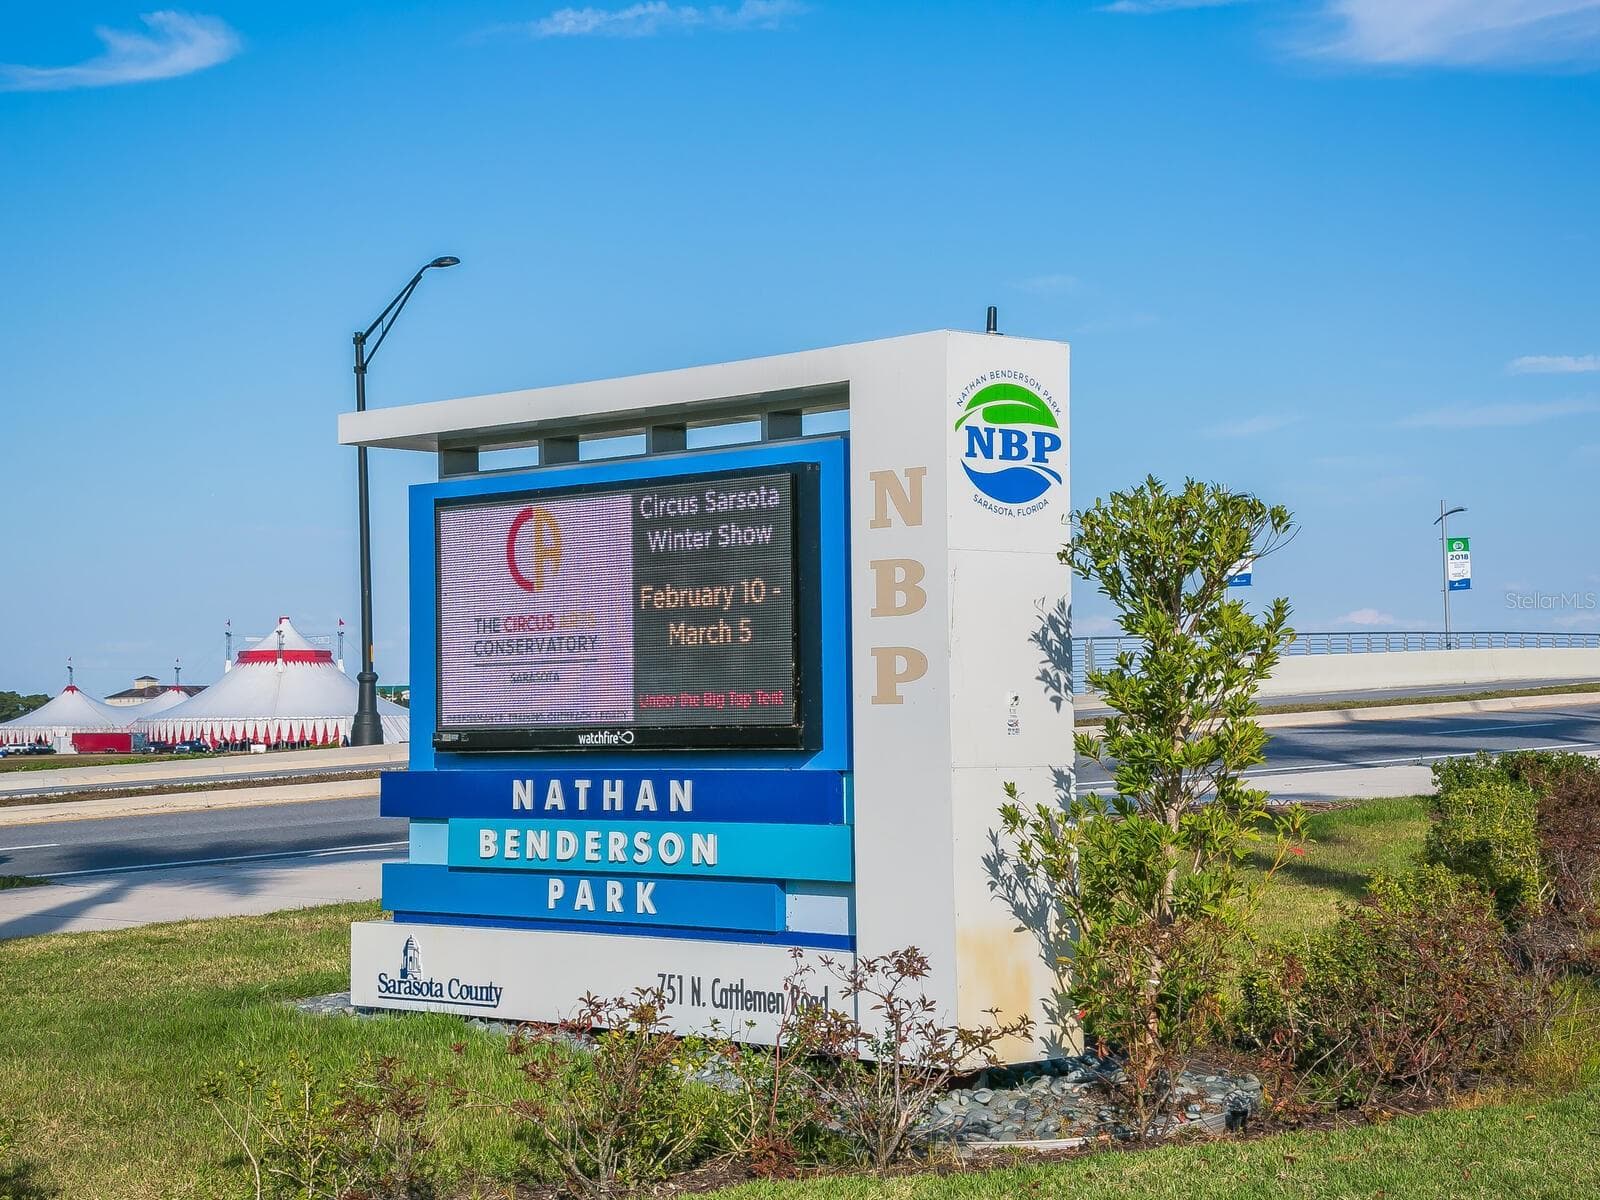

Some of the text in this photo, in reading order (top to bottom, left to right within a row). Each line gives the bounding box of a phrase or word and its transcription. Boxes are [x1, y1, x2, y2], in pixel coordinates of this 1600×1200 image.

[956, 369, 1062, 416] NATHAN BENDERSON PARK
[964, 425, 1062, 464] NBP
[639, 485, 781, 519] Circus Sarsota
[972, 494, 1050, 518] SARASOTA, FLORIDA
[646, 522, 773, 553] Winter Show
[1449, 553, 1469, 561] 2018
[639, 583, 735, 611] February
[740, 577, 767, 604] 10
[474, 616, 501, 635] THE
[502, 612, 556, 633] CIRCUS
[669, 616, 753, 646] March 5
[474, 634, 599, 657] CONSERVATORY
[578, 730, 619, 745] watchfire
[512, 779, 695, 814] NATHAN
[478, 827, 719, 866] BENDERSON
[547, 877, 659, 915] PARK
[377, 972, 504, 1008] Sarasota County
[657, 973, 684, 1005] 751
[691, 975, 706, 1008] N.
[711, 977, 785, 1015] Cattlemen
